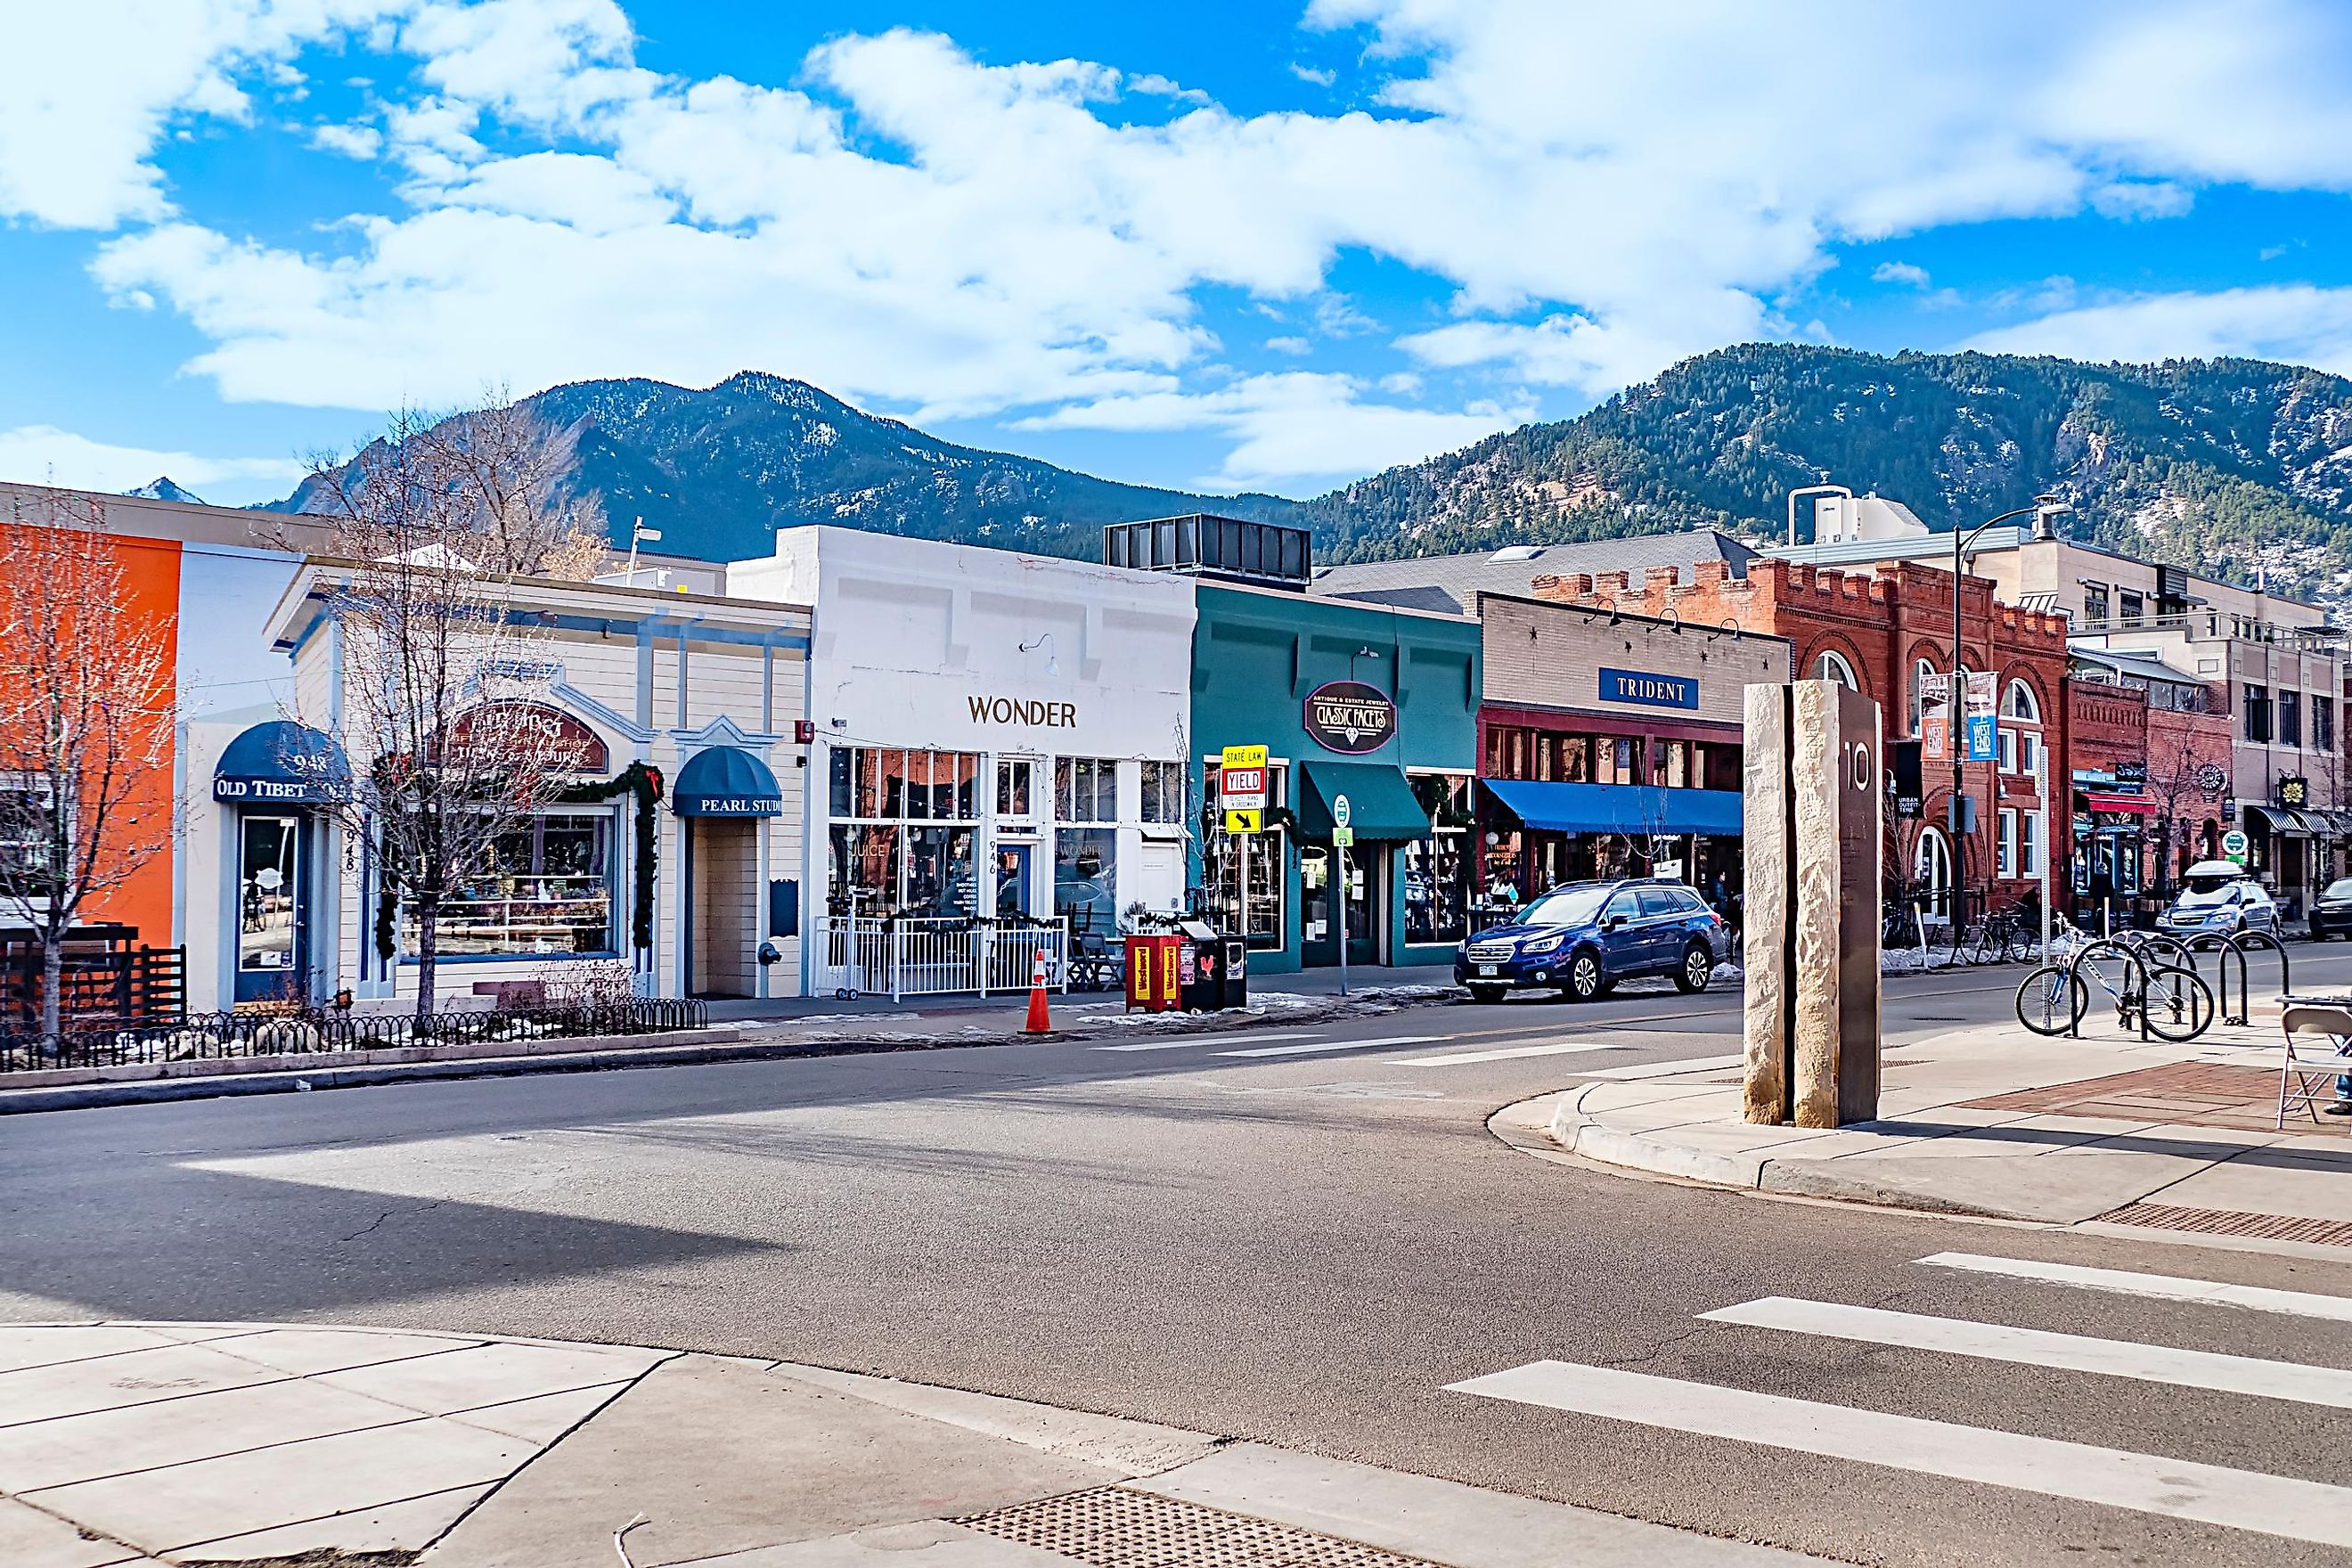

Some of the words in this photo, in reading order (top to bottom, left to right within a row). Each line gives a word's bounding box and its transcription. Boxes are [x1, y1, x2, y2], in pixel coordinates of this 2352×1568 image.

[1617, 677, 1686, 701] TRIDENT
[968, 695, 1076, 728] WONDER
[1316, 706, 1352, 726] CLASSIC
[1353, 708, 1386, 728] FACETS
[1925, 726, 1944, 738] WEST
[1972, 724, 1991, 736] WEST
[1927, 737, 1943, 749] END
[1974, 736, 1991, 748] END
[1226, 751, 1245, 763] STATE
[1248, 752, 1262, 762] LAW
[1844, 741, 1870, 791] 10
[1229, 772, 1260, 788] YIELD
[216, 780, 248, 796] OLD
[251, 780, 307, 798] TIBET
[700, 799, 750, 812] PEARL
[345, 829, 356, 871] 948
[851, 844, 886, 857] JUICE
[1059, 845, 1105, 856] WONDER
[1138, 947, 1147, 992] Westword
[1166, 947, 1174, 992] Westword
